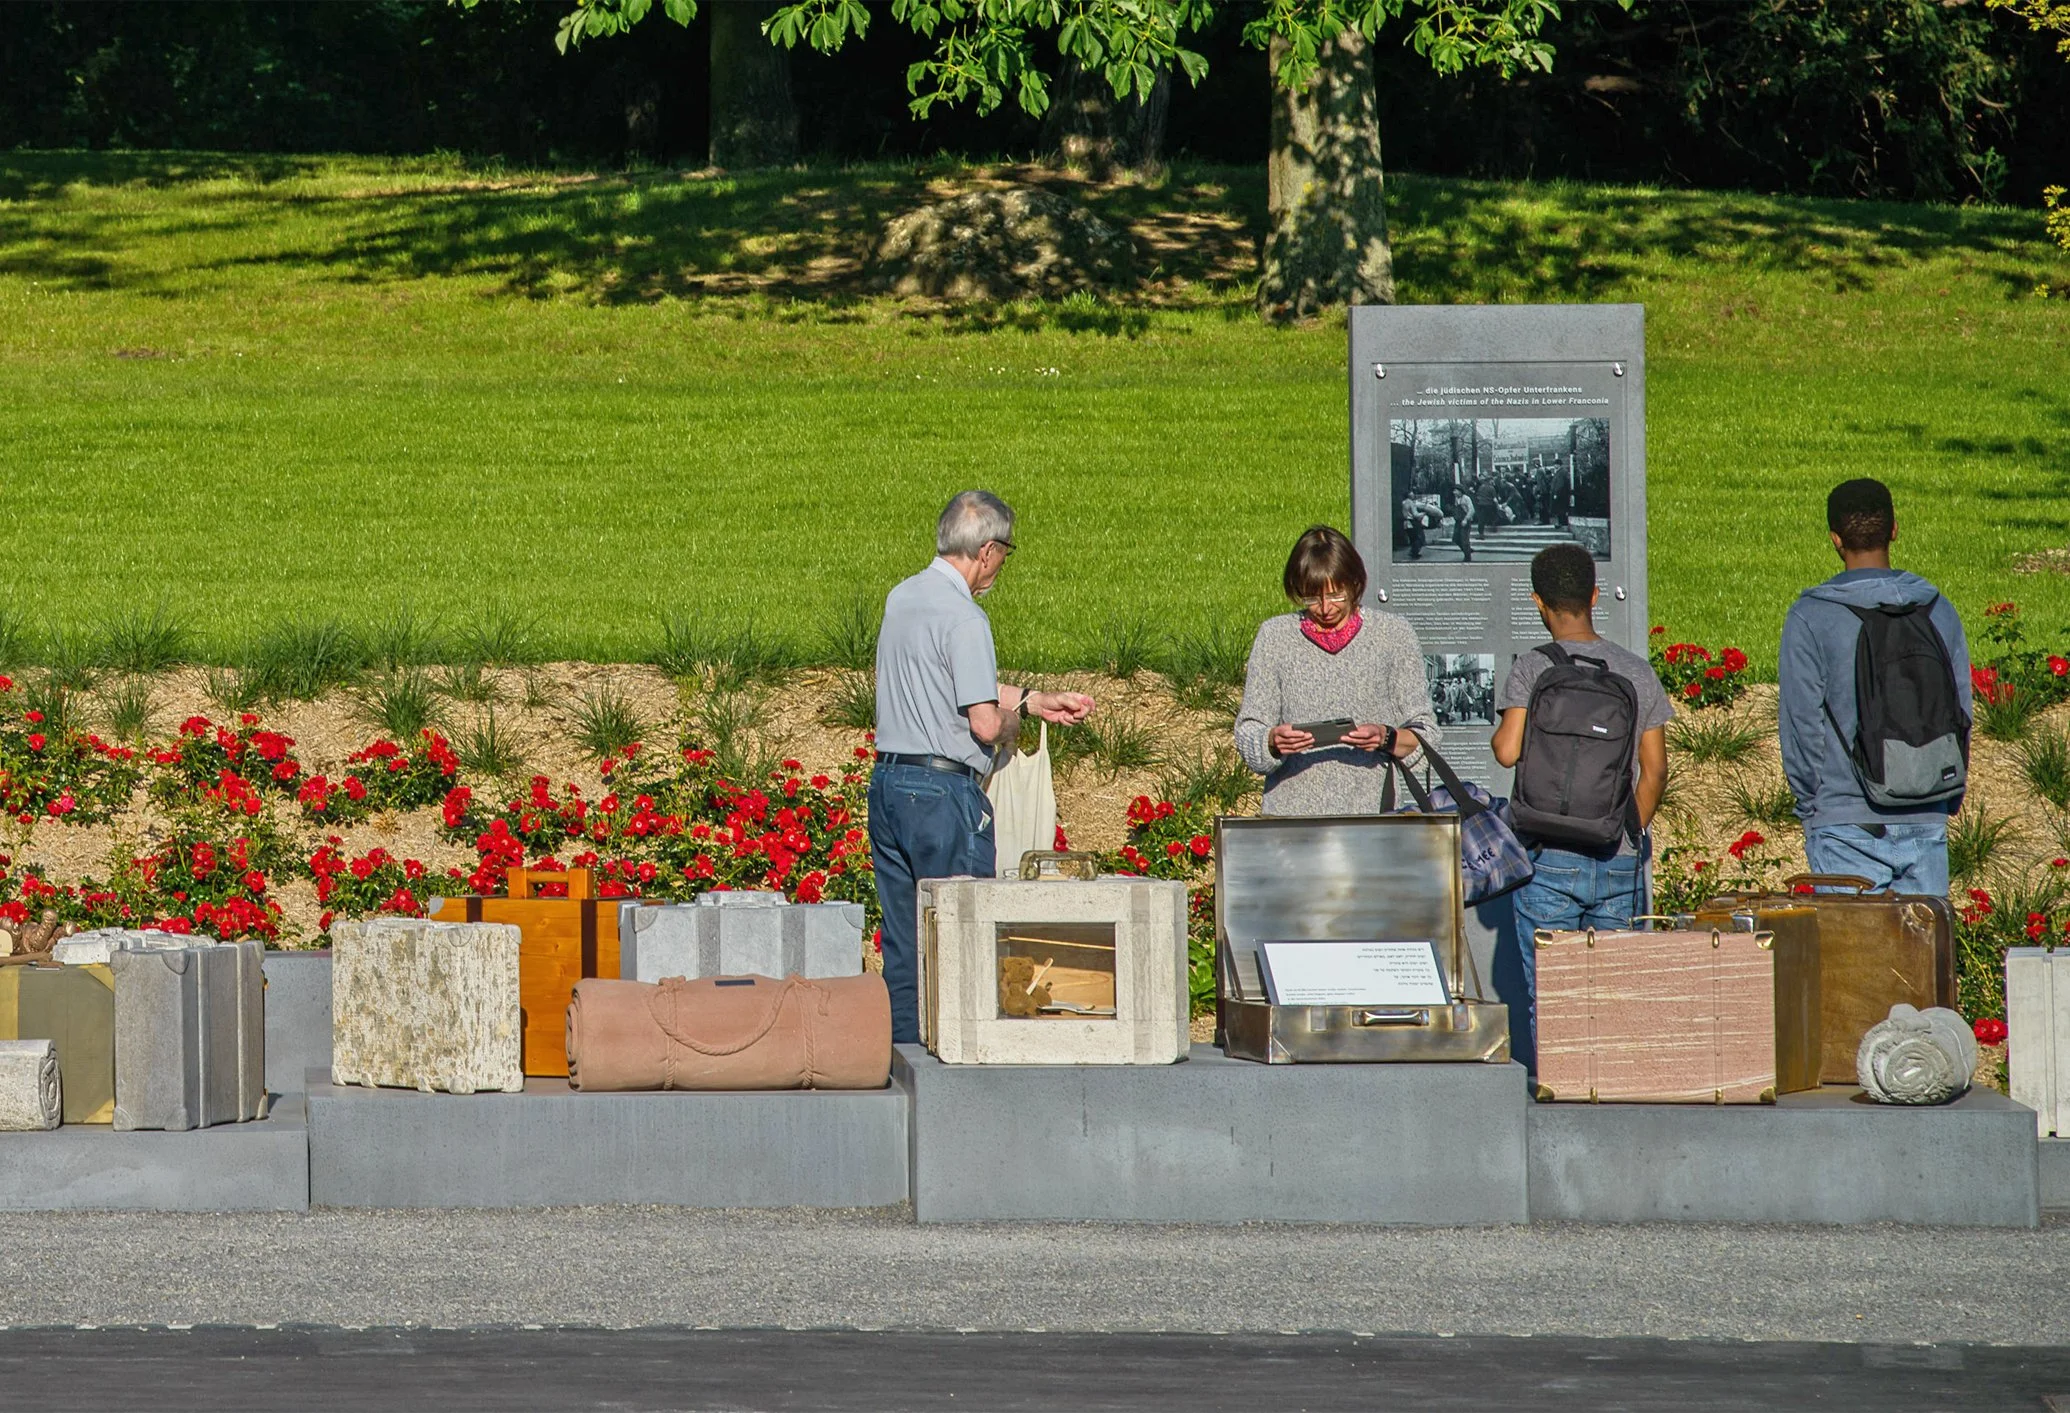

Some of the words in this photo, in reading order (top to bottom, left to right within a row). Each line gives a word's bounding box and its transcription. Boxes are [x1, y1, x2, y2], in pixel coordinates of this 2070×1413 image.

[1425, 386, 1439, 395] die
[1440, 386, 1481, 396] jüdischen
[1483, 386, 1521, 395] NS-Opfer
[1523, 385, 1583, 394] Unterfrankens
[1401, 398, 1415, 406] the
[1417, 398, 1446, 406] Jewish
[1448, 397, 1477, 406] victims
[1480, 397, 1489, 405] of
[1491, 397, 1504, 405] the
[1506, 397, 1529, 405] Nazis
[1531, 397, 1540, 405] in
[1541, 397, 1566, 405] Lower
[1568, 396, 1609, 404] Franconia
